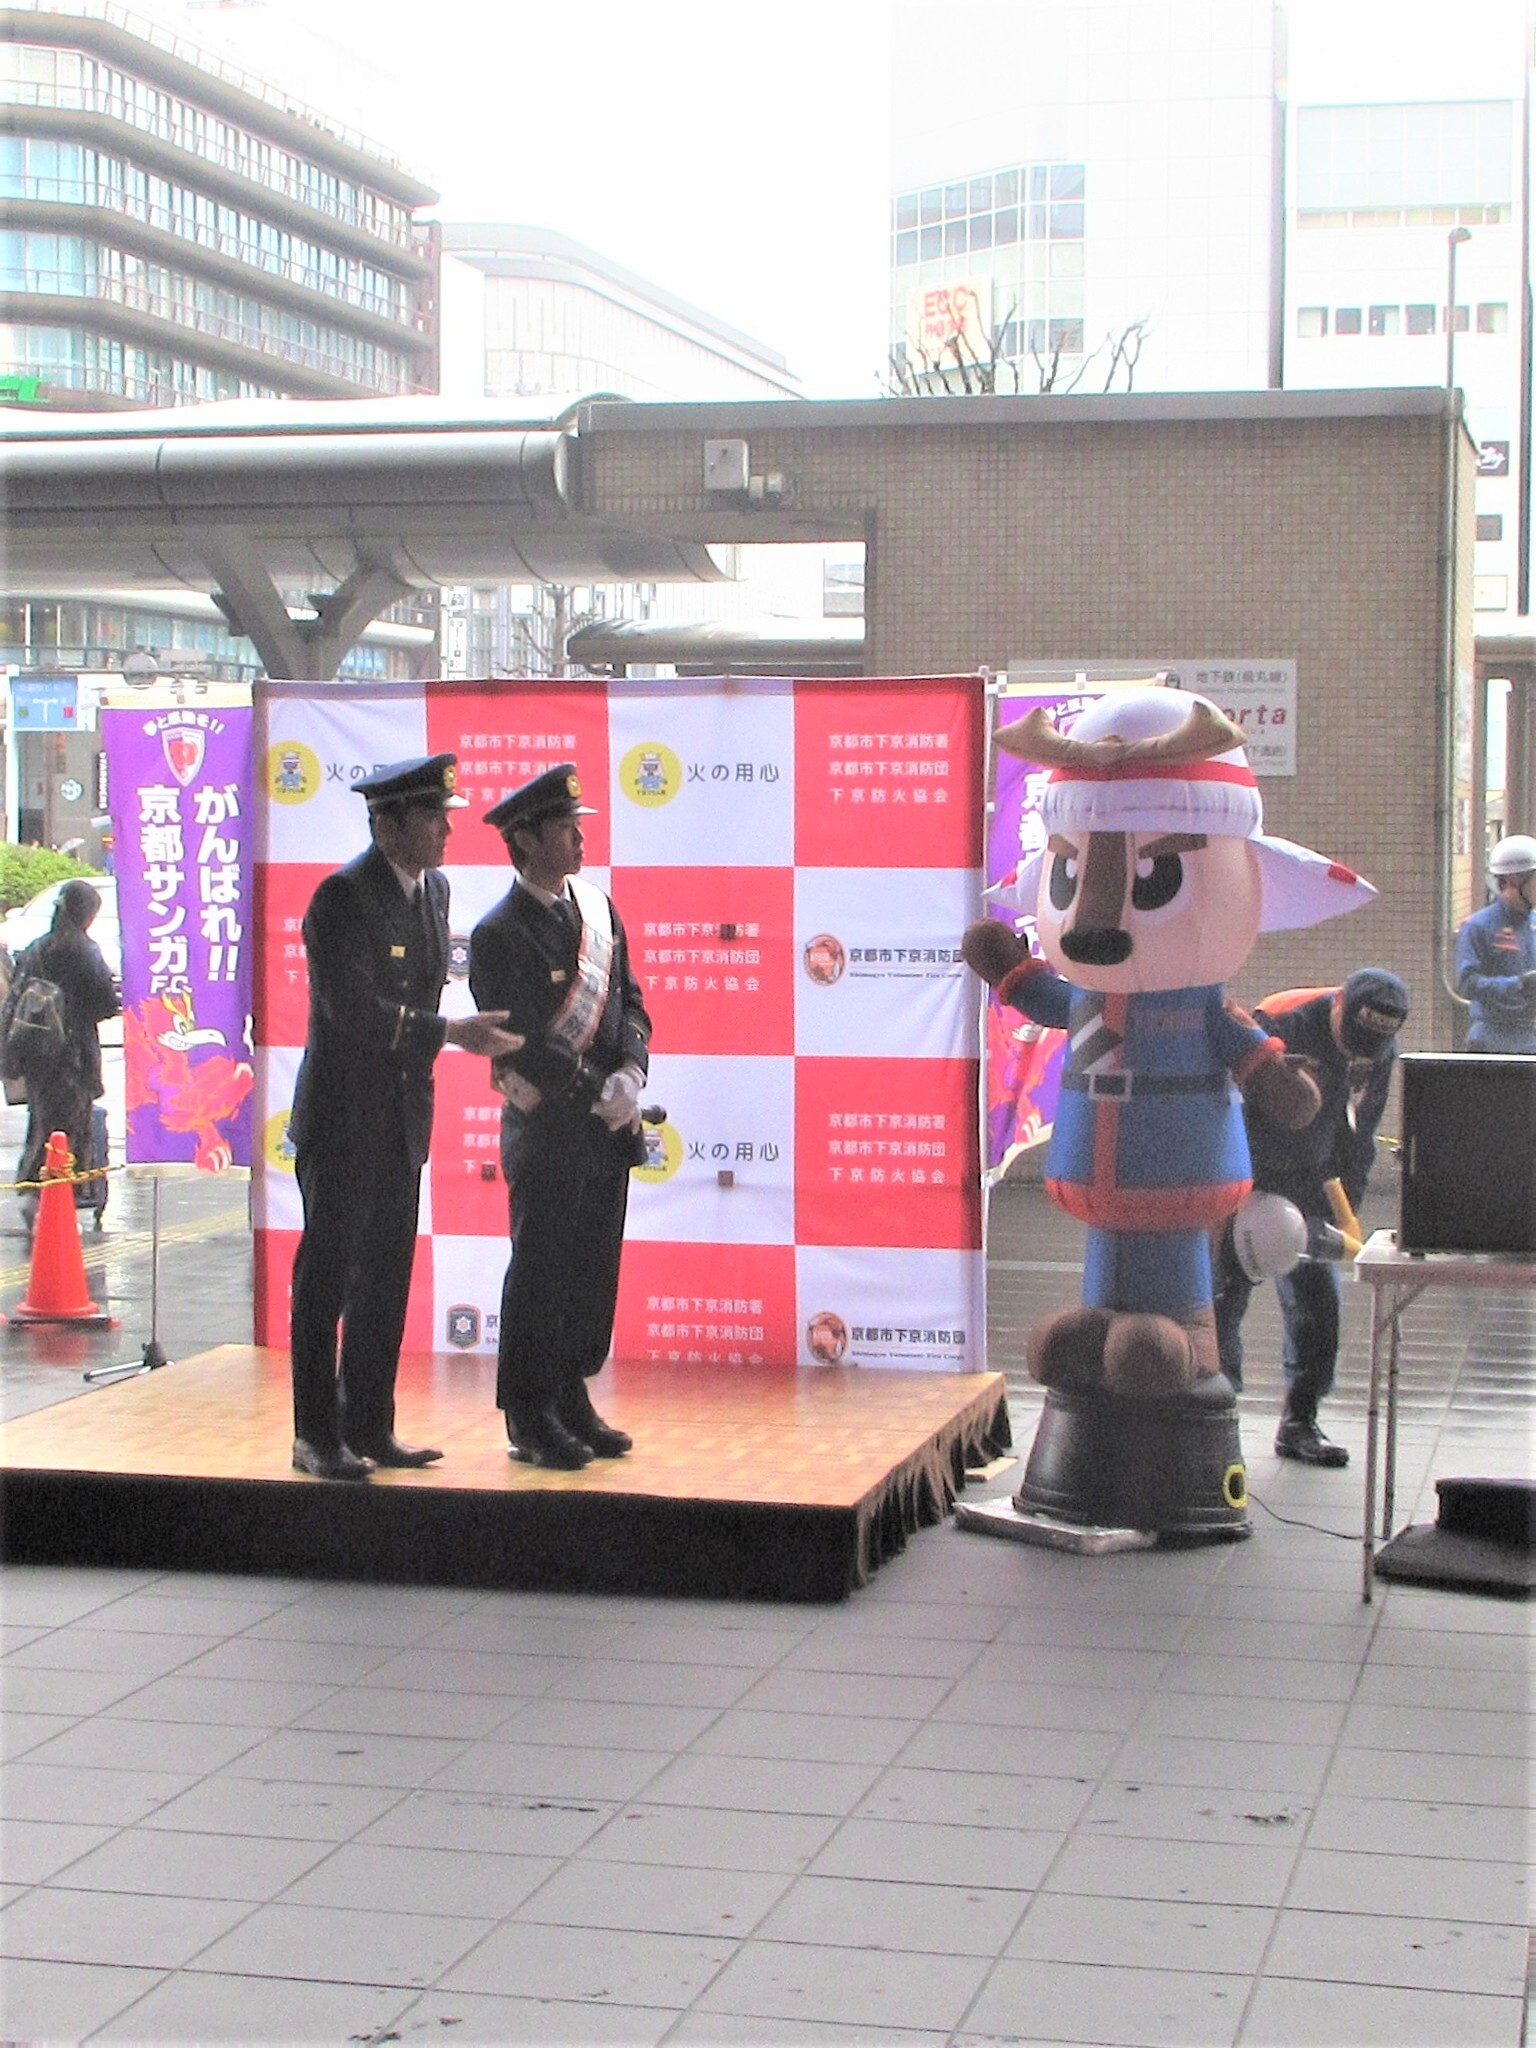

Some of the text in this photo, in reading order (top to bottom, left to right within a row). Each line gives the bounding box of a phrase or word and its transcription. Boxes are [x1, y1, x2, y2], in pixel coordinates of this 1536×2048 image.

[687, 763, 780, 783] 火の用心
[829, 761, 949, 776] 京都市下京消防団
[193, 783, 244, 982] がんばれ!!
[643, 949, 760, 965] 京都市下京消防団
[688, 1142, 780, 1162] 火の用心
[828, 1140, 946, 1157] 京都市下京消防団
